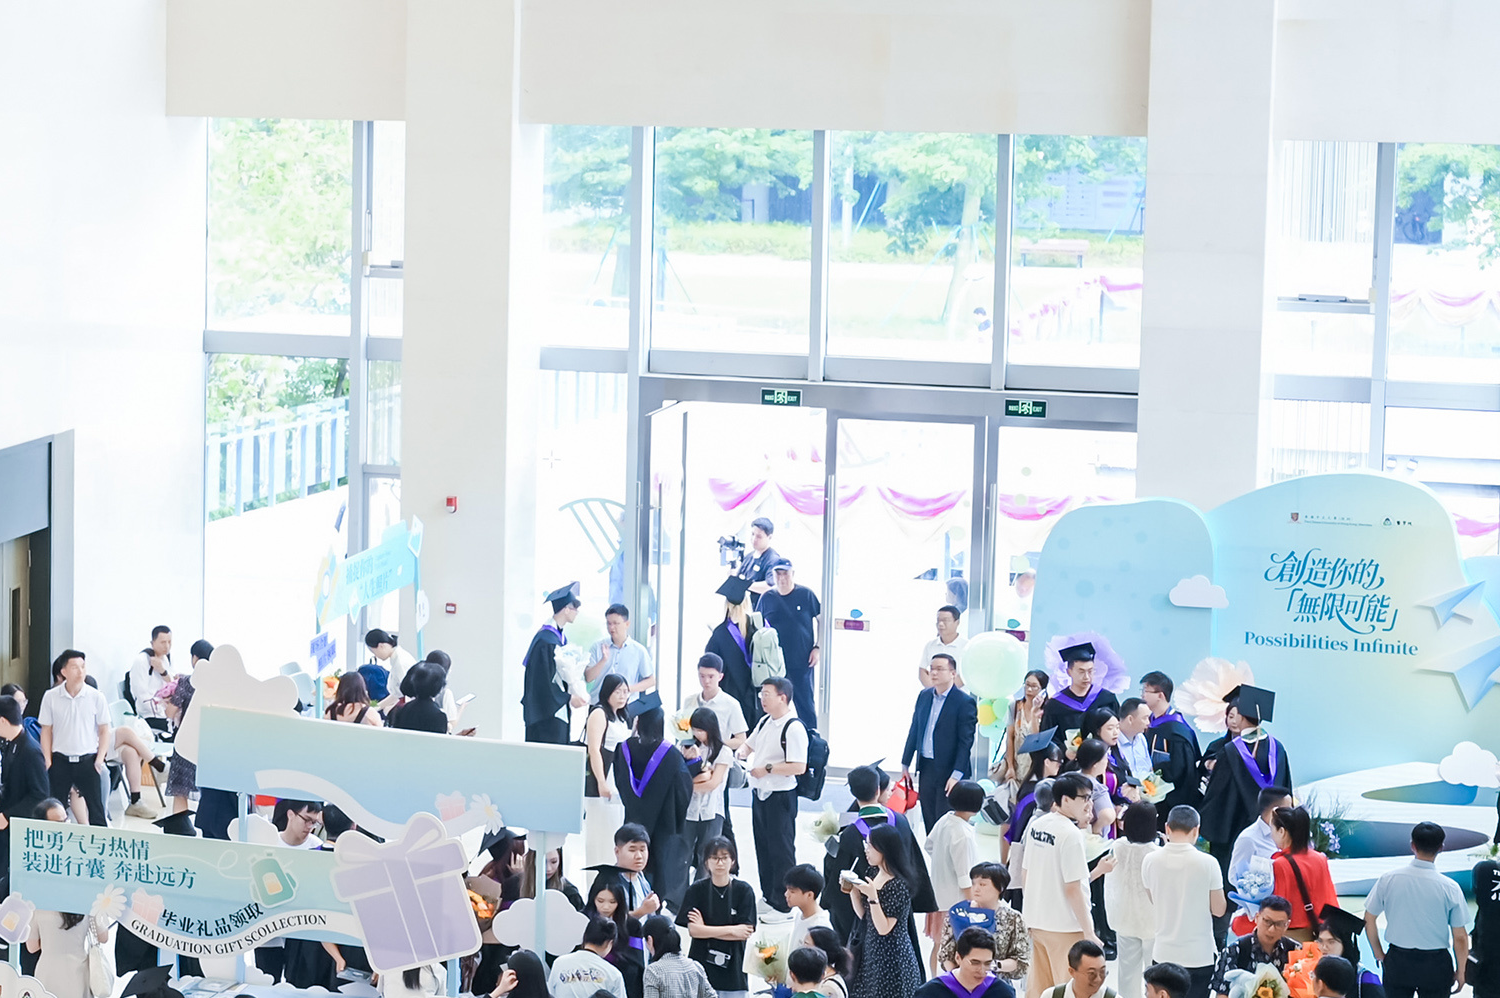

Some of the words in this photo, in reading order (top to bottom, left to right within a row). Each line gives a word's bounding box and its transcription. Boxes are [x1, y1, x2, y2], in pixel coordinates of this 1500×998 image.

[1264, 548, 1385, 591] 創造你的
[1286, 588, 1398, 635] 「無限可能」
[1244, 631, 1348, 651] Possibilities
[1353, 638, 1419, 656] Infinite
[23, 827, 150, 861] 把勇气与热情
[22, 851, 106, 880] 装进行囊
[113, 861, 197, 890] 奔赴远方
[131, 919, 212, 955] GRADUATION
[215, 941, 243, 955] GIFT
[159, 902, 264, 937] 毕业礼品领取
